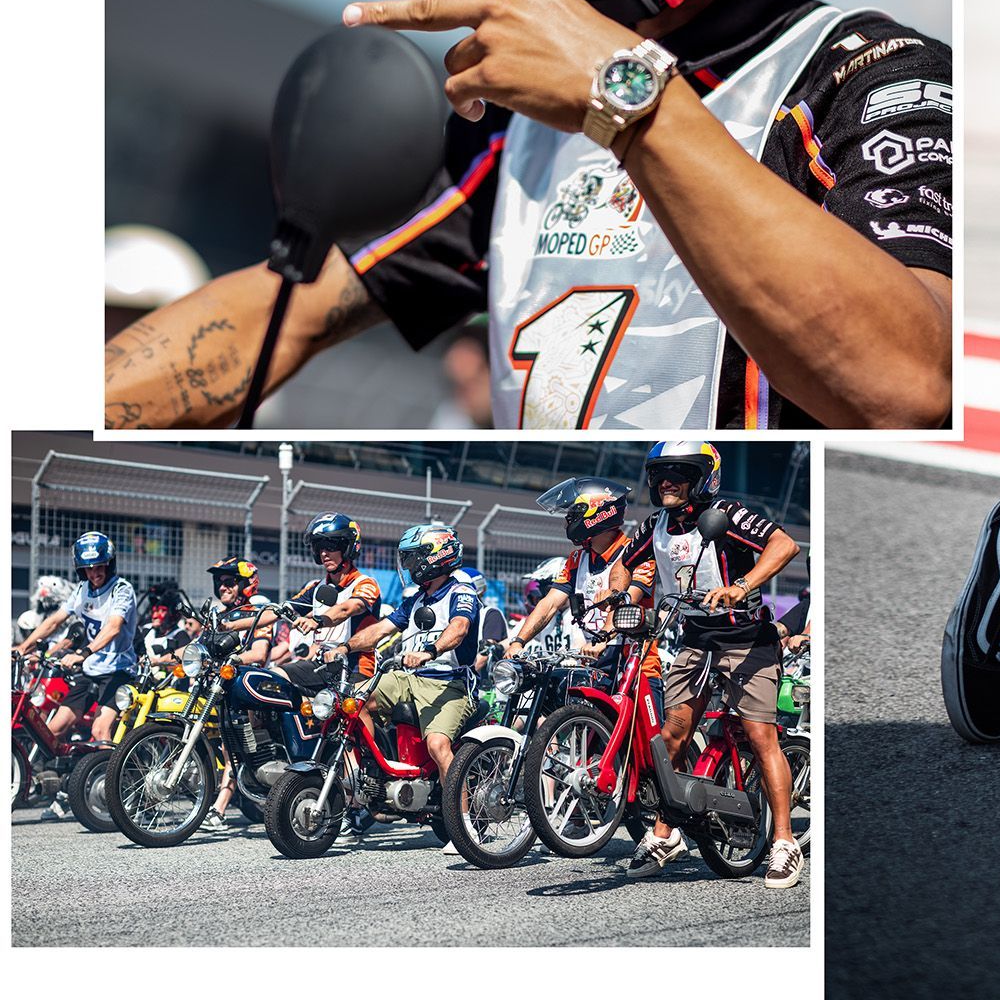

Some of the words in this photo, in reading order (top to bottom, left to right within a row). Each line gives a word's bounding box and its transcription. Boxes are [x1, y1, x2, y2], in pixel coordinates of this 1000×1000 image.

[916, 137, 952, 153] PA
[919, 186, 942, 207] fast
[535, 231, 587, 256] MOPED
[588, 234, 611, 256] GP
[509, 285, 640, 429] 1
[584, 514, 602, 529] Red
[601, 505, 618, 521] Bull
[427, 552, 443, 565] Red
[675, 564, 697, 593] 1
